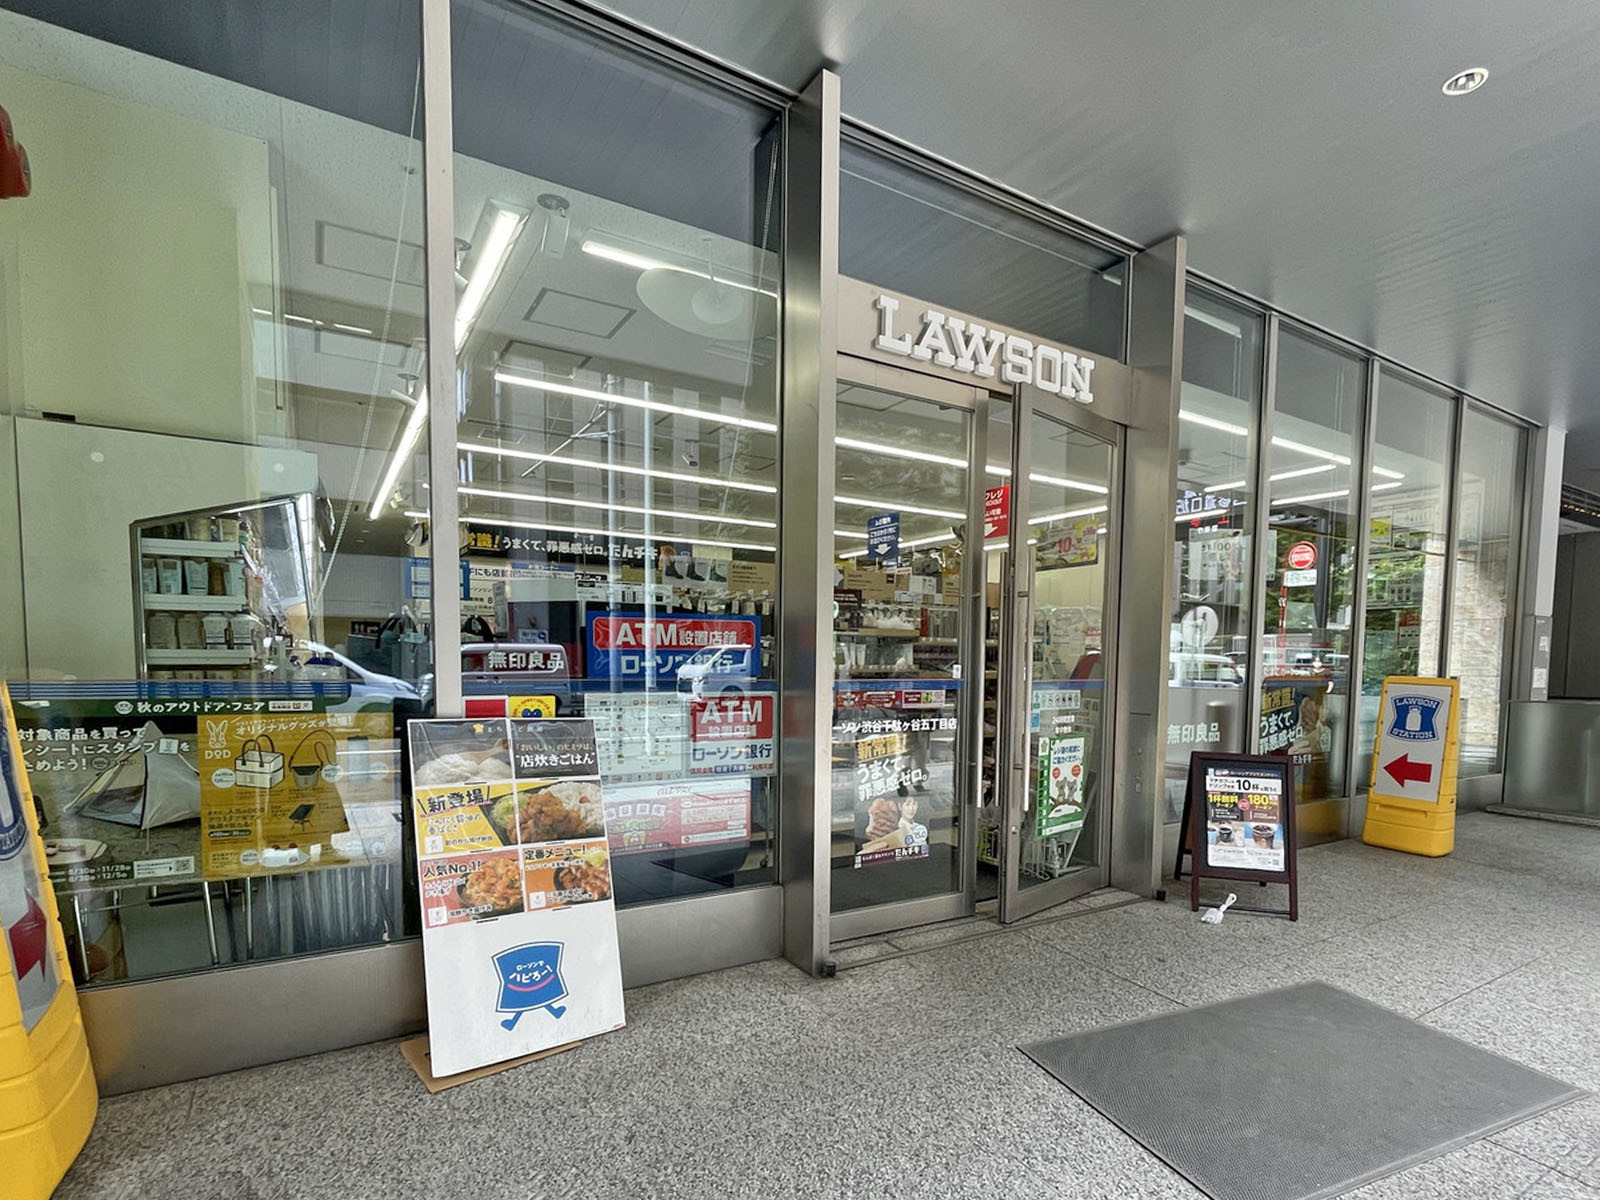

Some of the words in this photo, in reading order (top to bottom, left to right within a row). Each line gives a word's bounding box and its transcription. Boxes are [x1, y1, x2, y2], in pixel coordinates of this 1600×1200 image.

[876, 295, 1095, 404] LAWSON
[488, 651, 564, 669] 無印良品
[137, 701, 265, 714] 秋のアウトドア・フェア
[701, 699, 763, 724] ATM
[1396, 698, 1437, 708] LAWSON
[19, 727, 147, 741] 対象商品を買って
[1167, 722, 1220, 744] 無印良品
[692, 743, 772, 761] ローソン銀行
[428, 787, 484, 812] 新登場
[524, 844, 585, 861] 定番メニュー!
